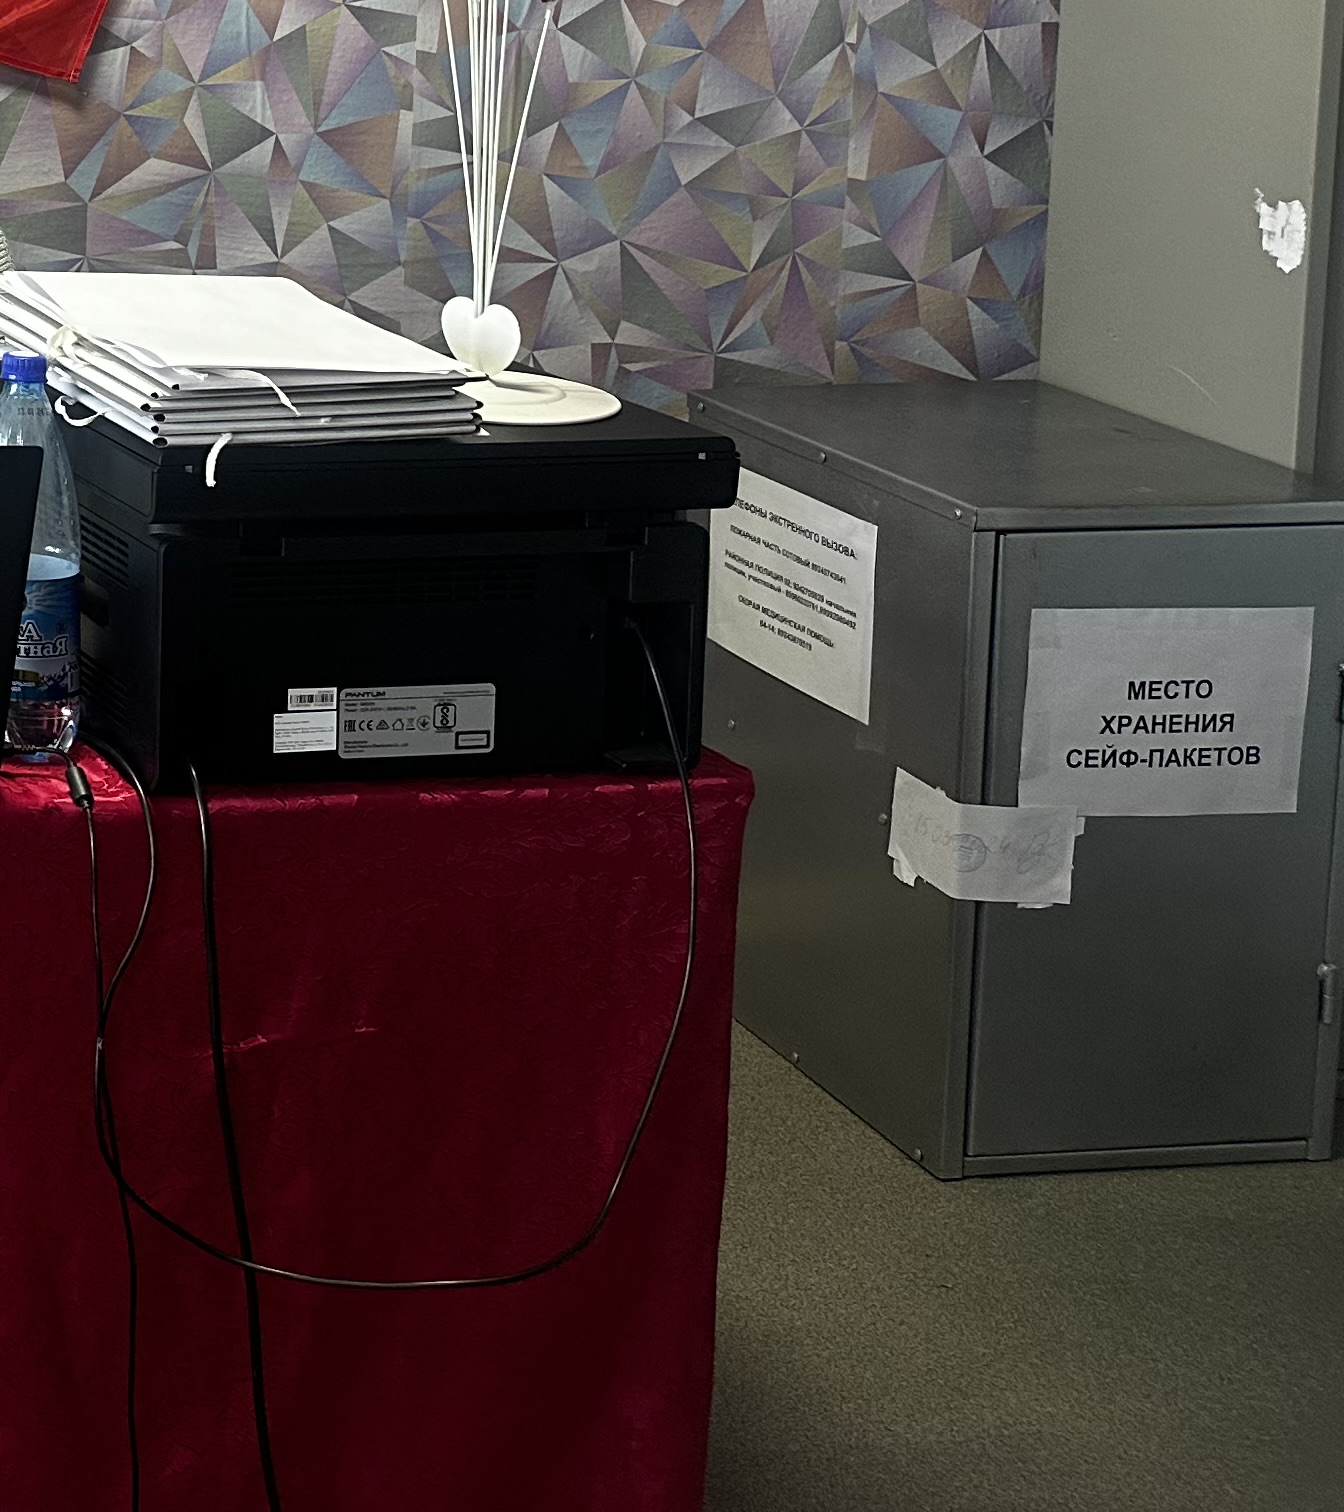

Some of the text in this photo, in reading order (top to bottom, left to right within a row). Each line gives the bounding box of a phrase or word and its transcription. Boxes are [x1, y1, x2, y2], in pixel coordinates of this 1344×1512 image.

[733, 496, 766, 519] ЛЕФОНЫ
[344, 690, 387, 699] PANTUM
[1127, 679, 1214, 700] МЕСТО
[1099, 713, 1235, 735] ХРАНЕНИЯ
[1066, 744, 1261, 768] СЕЙФ-ПАКЕТОВ
